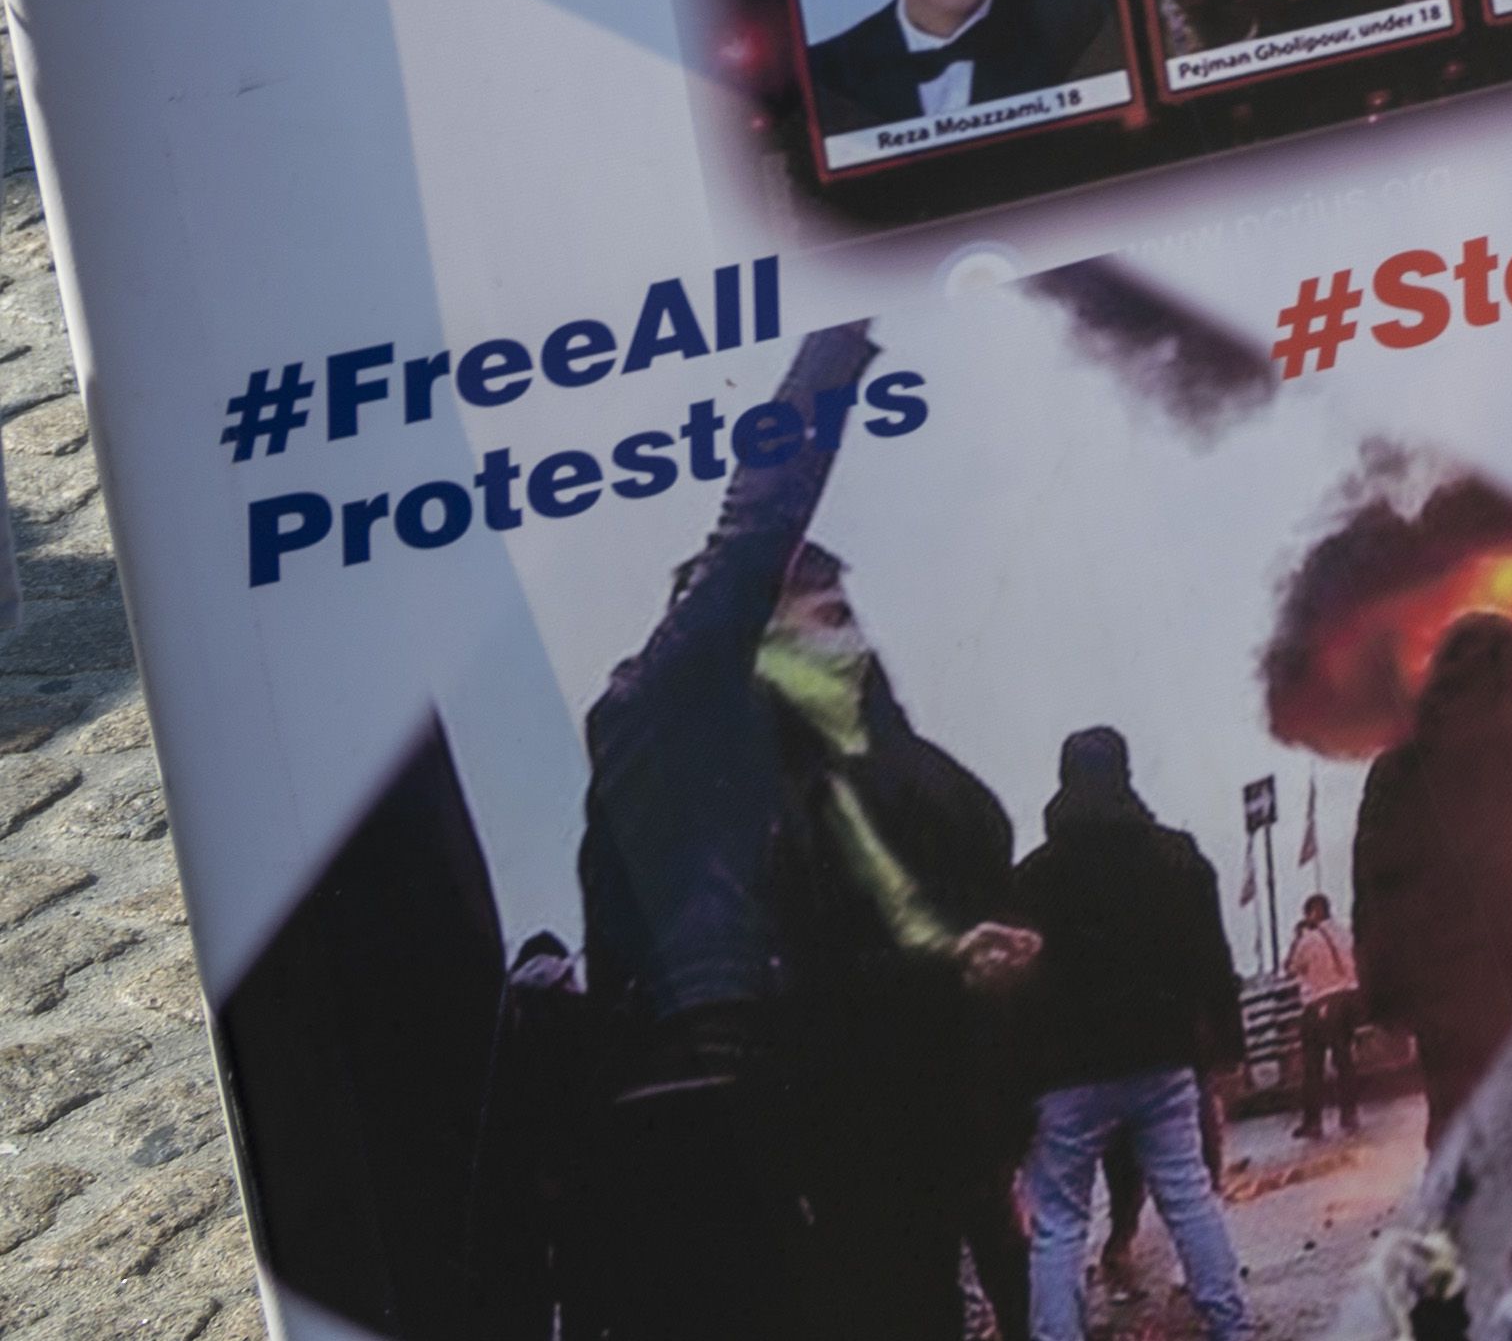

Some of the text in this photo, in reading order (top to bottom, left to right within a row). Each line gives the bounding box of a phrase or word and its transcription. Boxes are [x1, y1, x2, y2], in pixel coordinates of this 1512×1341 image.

[1177, 4, 1442, 81] Pejman Gholipour, under 18
[877, 123, 930, 149] Reza
[1055, 88, 1083, 109] 18
[219, 254, 781, 464] #FreeAll
[248, 369, 930, 589] Protesters
